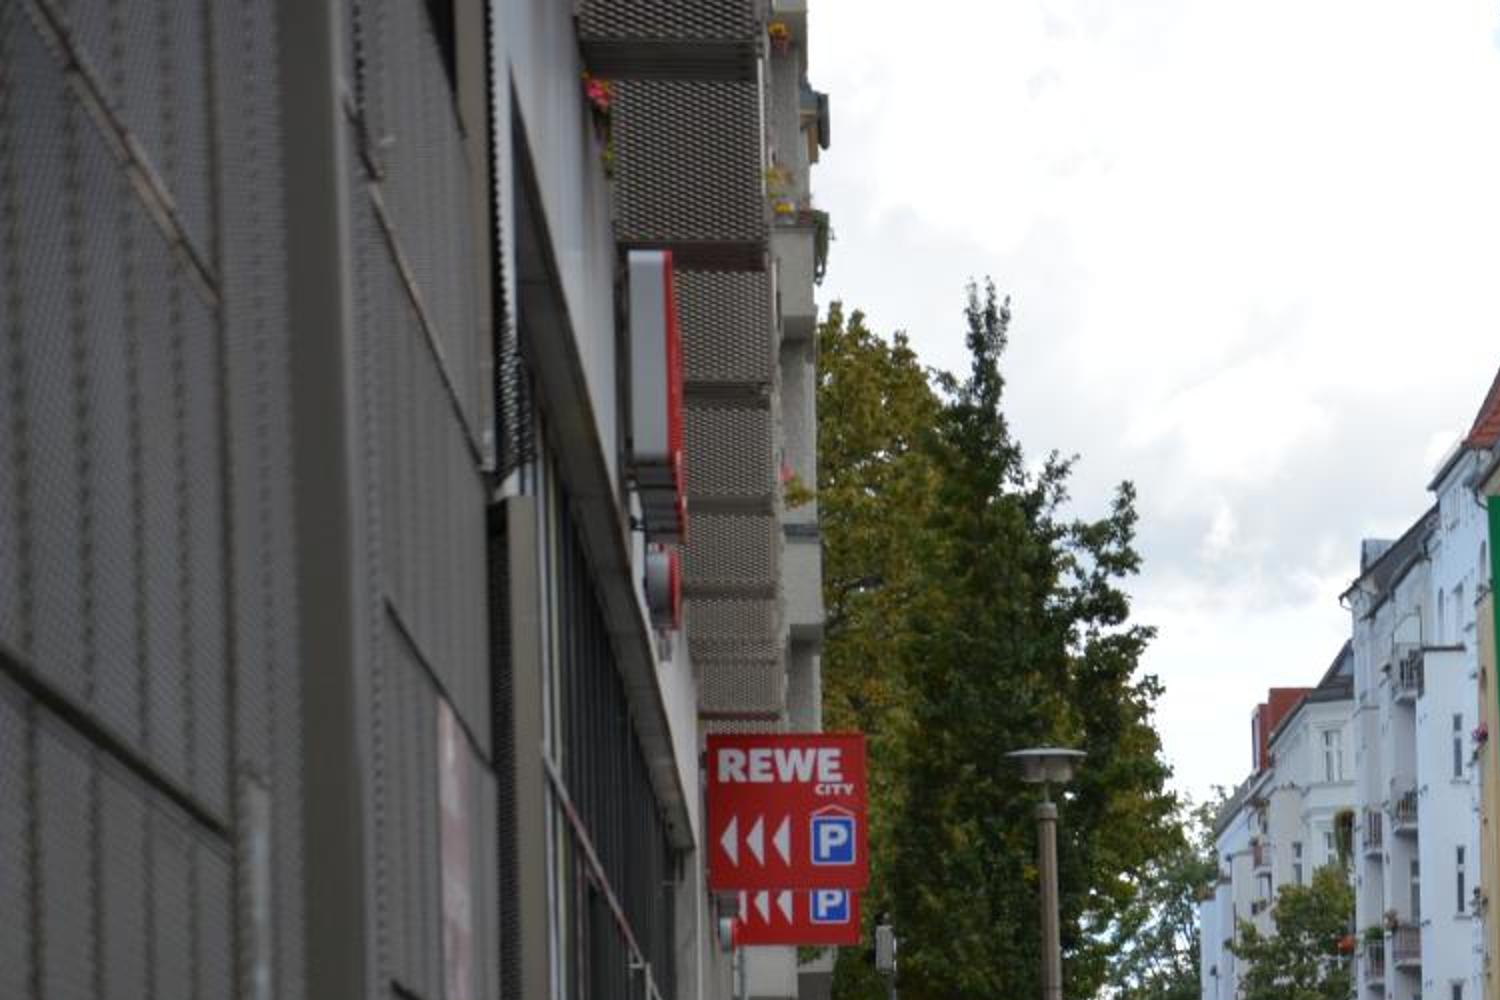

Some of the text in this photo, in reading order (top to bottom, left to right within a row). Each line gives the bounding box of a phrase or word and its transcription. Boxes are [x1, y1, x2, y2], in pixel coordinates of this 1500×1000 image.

[717, 747, 843, 783] REWE
[815, 783, 854, 796] CITY
[819, 823, 848, 858] P
[817, 888, 844, 918] P
